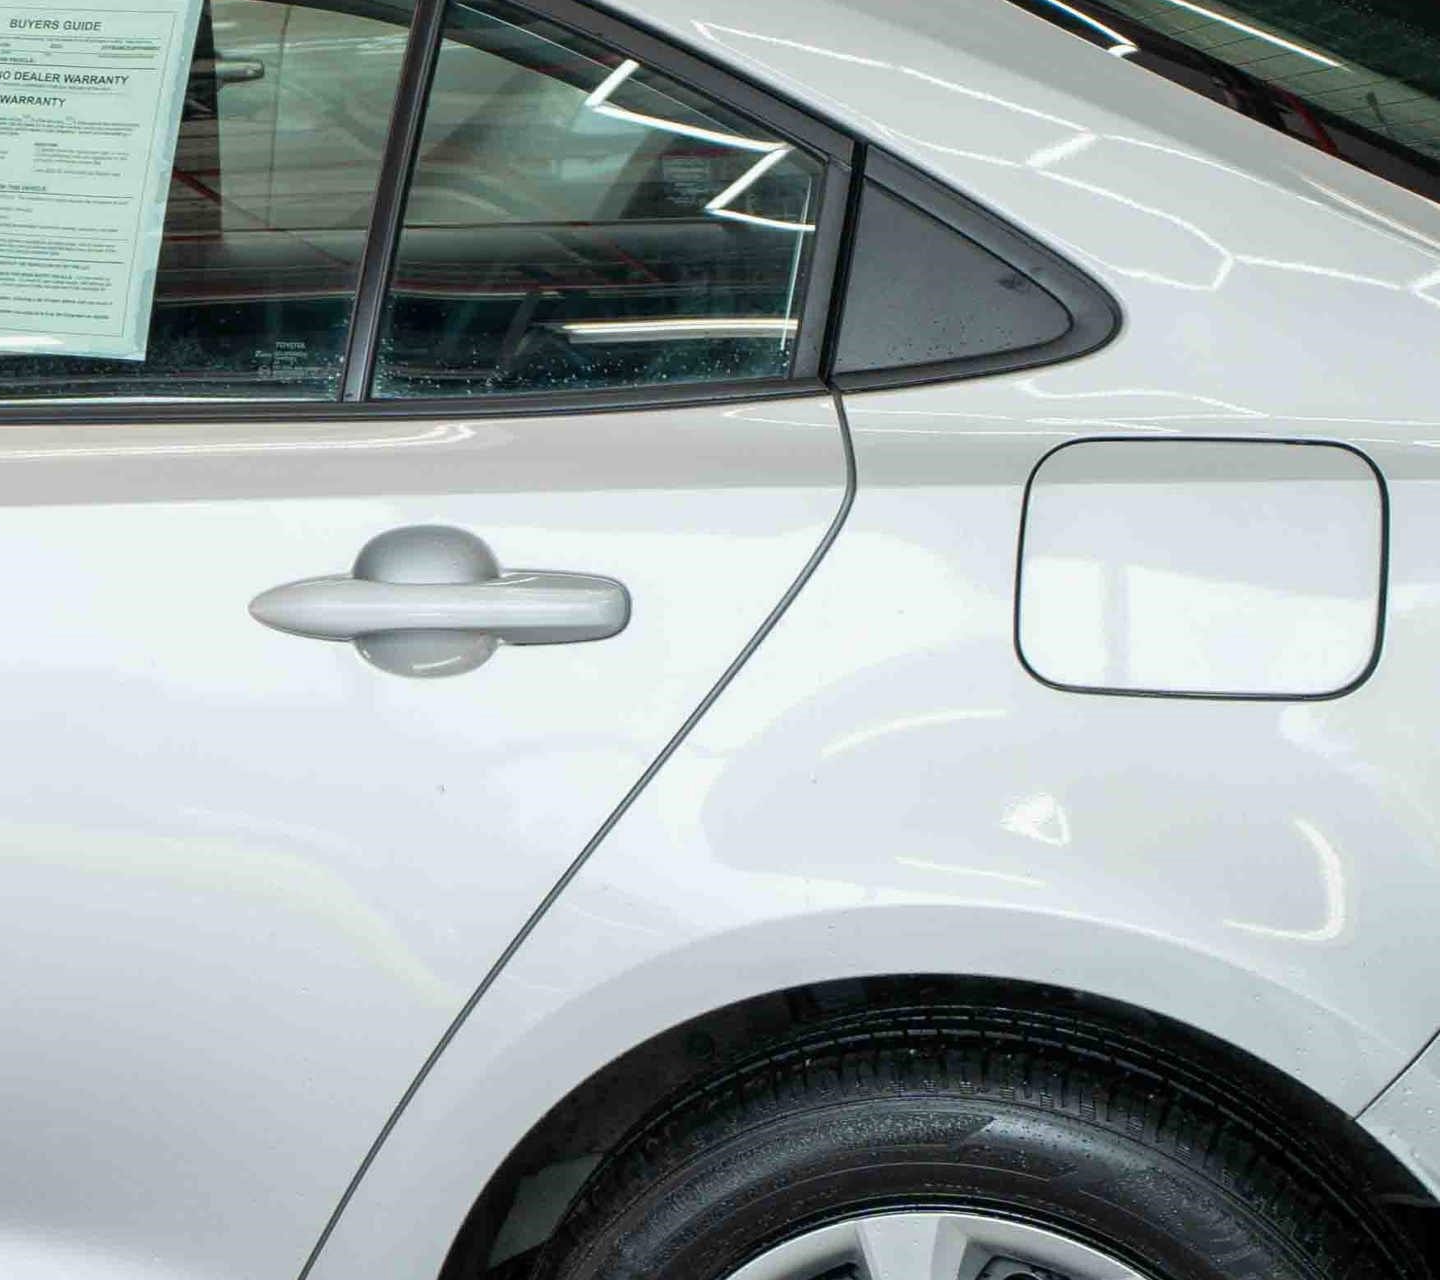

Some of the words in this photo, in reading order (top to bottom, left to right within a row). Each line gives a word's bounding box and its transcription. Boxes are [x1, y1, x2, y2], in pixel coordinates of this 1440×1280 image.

[9, 19, 59, 31] BUYERS
[63, 21, 103, 31] GUIDE
[14, 71, 60, 83] DEALER
[64, 73, 129, 85] WARRANTY
[0, 95, 66, 108] WARRANTY
